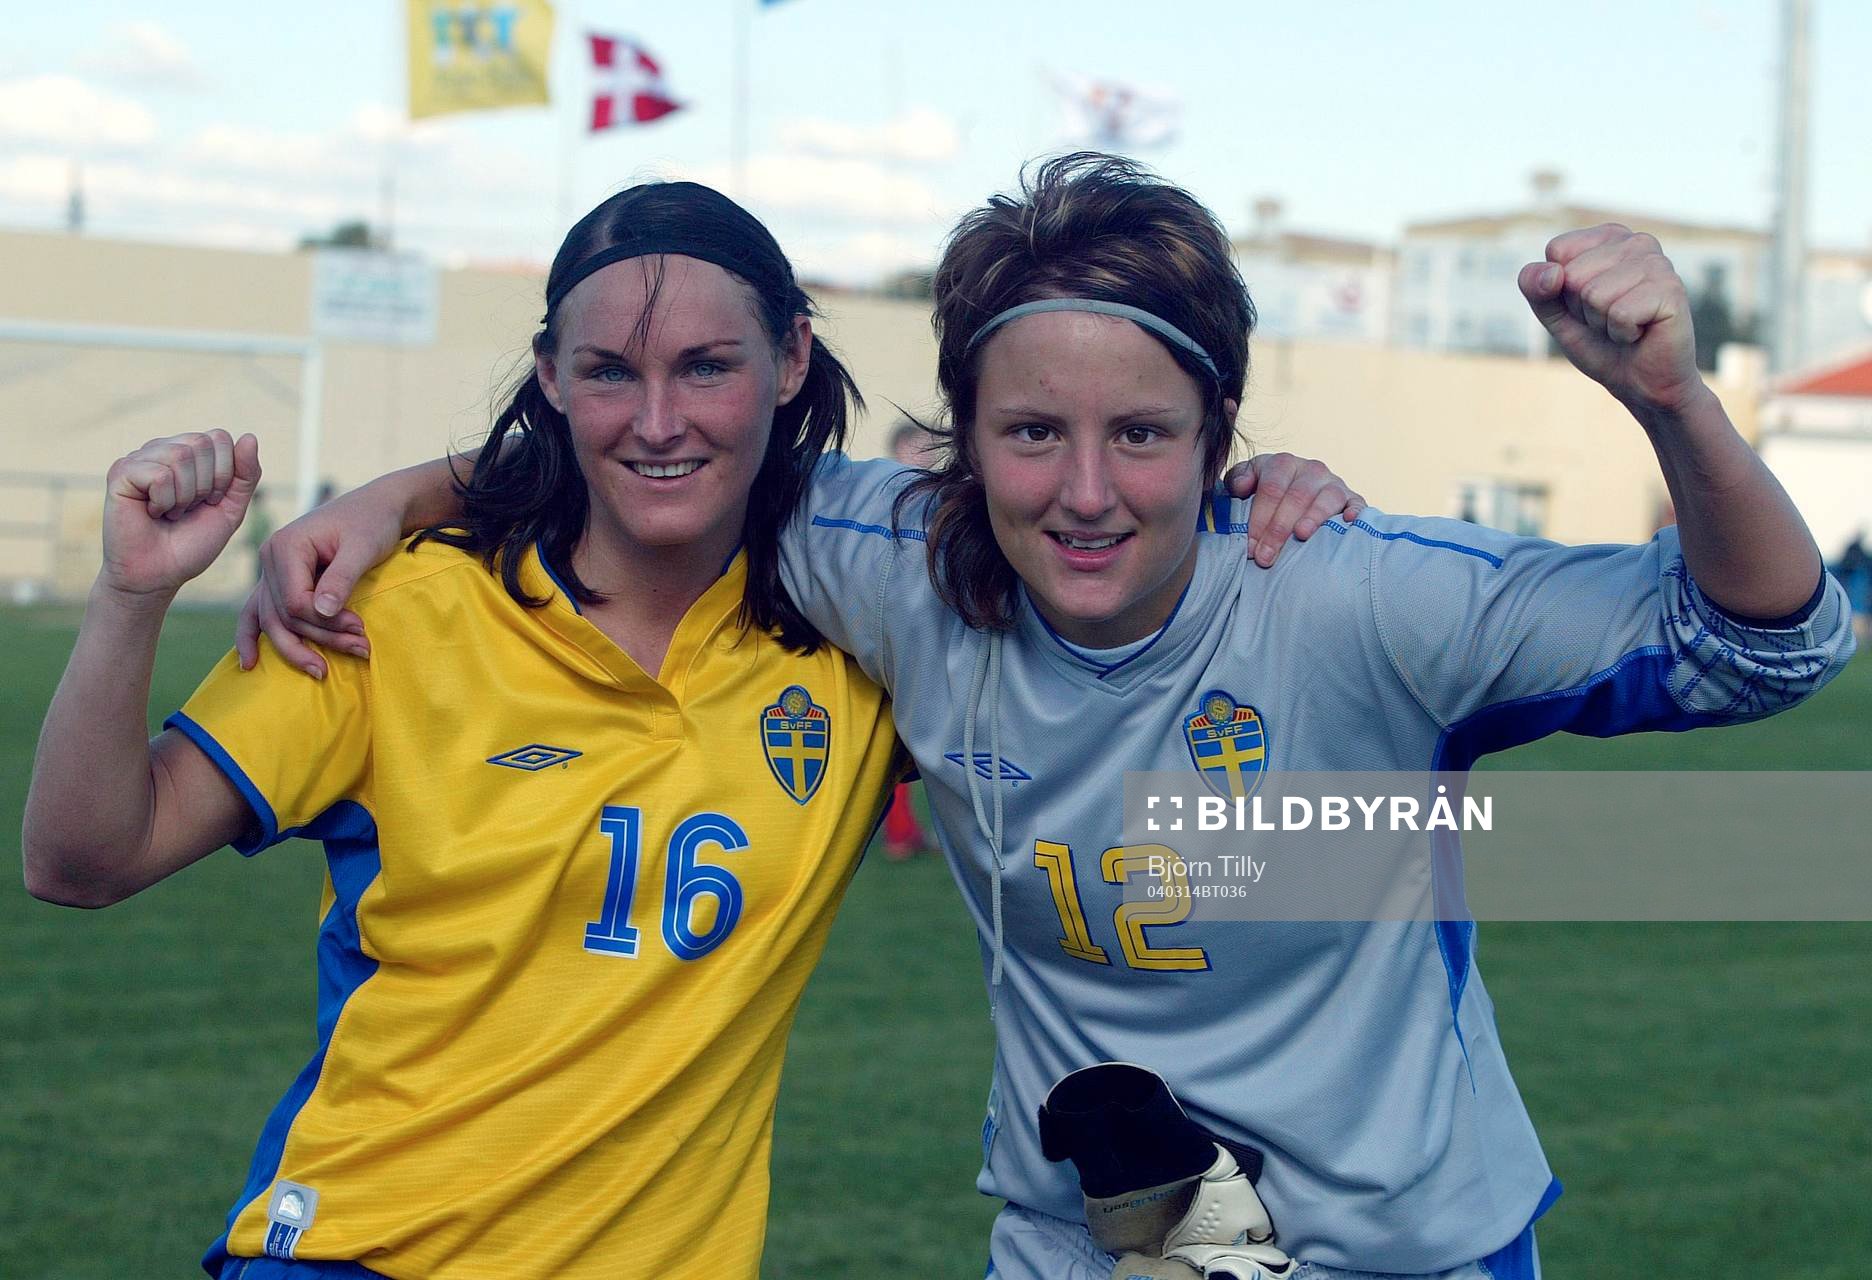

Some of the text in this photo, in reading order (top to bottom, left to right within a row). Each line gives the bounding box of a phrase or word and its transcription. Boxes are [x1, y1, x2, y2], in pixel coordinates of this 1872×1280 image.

[780, 721, 812, 730] SvFF
[1206, 725, 1243, 739] SvFF
[583, 804, 750, 962] 16
[1034, 838, 1213, 972] 12
